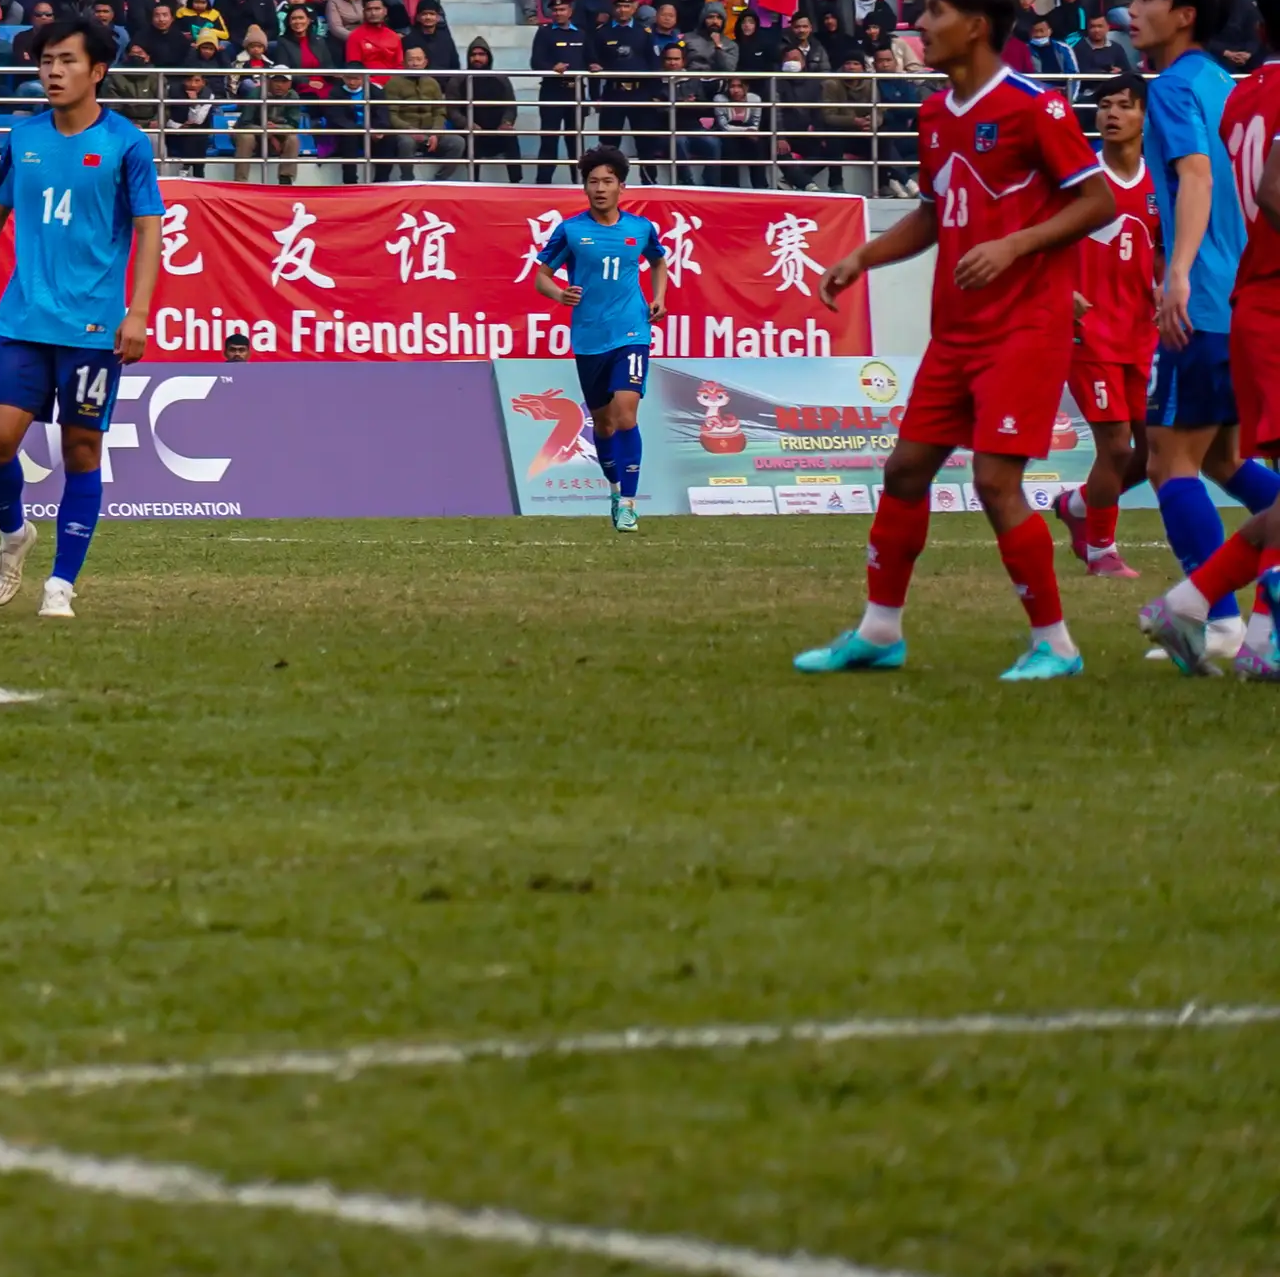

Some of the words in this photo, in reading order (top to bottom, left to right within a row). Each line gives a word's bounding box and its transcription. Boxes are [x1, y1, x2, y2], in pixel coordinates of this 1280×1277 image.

[42, 187, 73, 226] 14
[942, 187, 969, 228] 23
[1119, 232, 1133, 261] 5
[602, 256, 621, 281] 11
[292, 309, 513, 360] Friendship
[704, 315, 831, 358] Match
[627, 353, 643, 377] 11
[76, 365, 108, 406] 14
[1093, 380, 1108, 410] 5
[780, 435, 866, 451] FRIENDSHIP
[107, 502, 242, 517] CONFEDERATION
